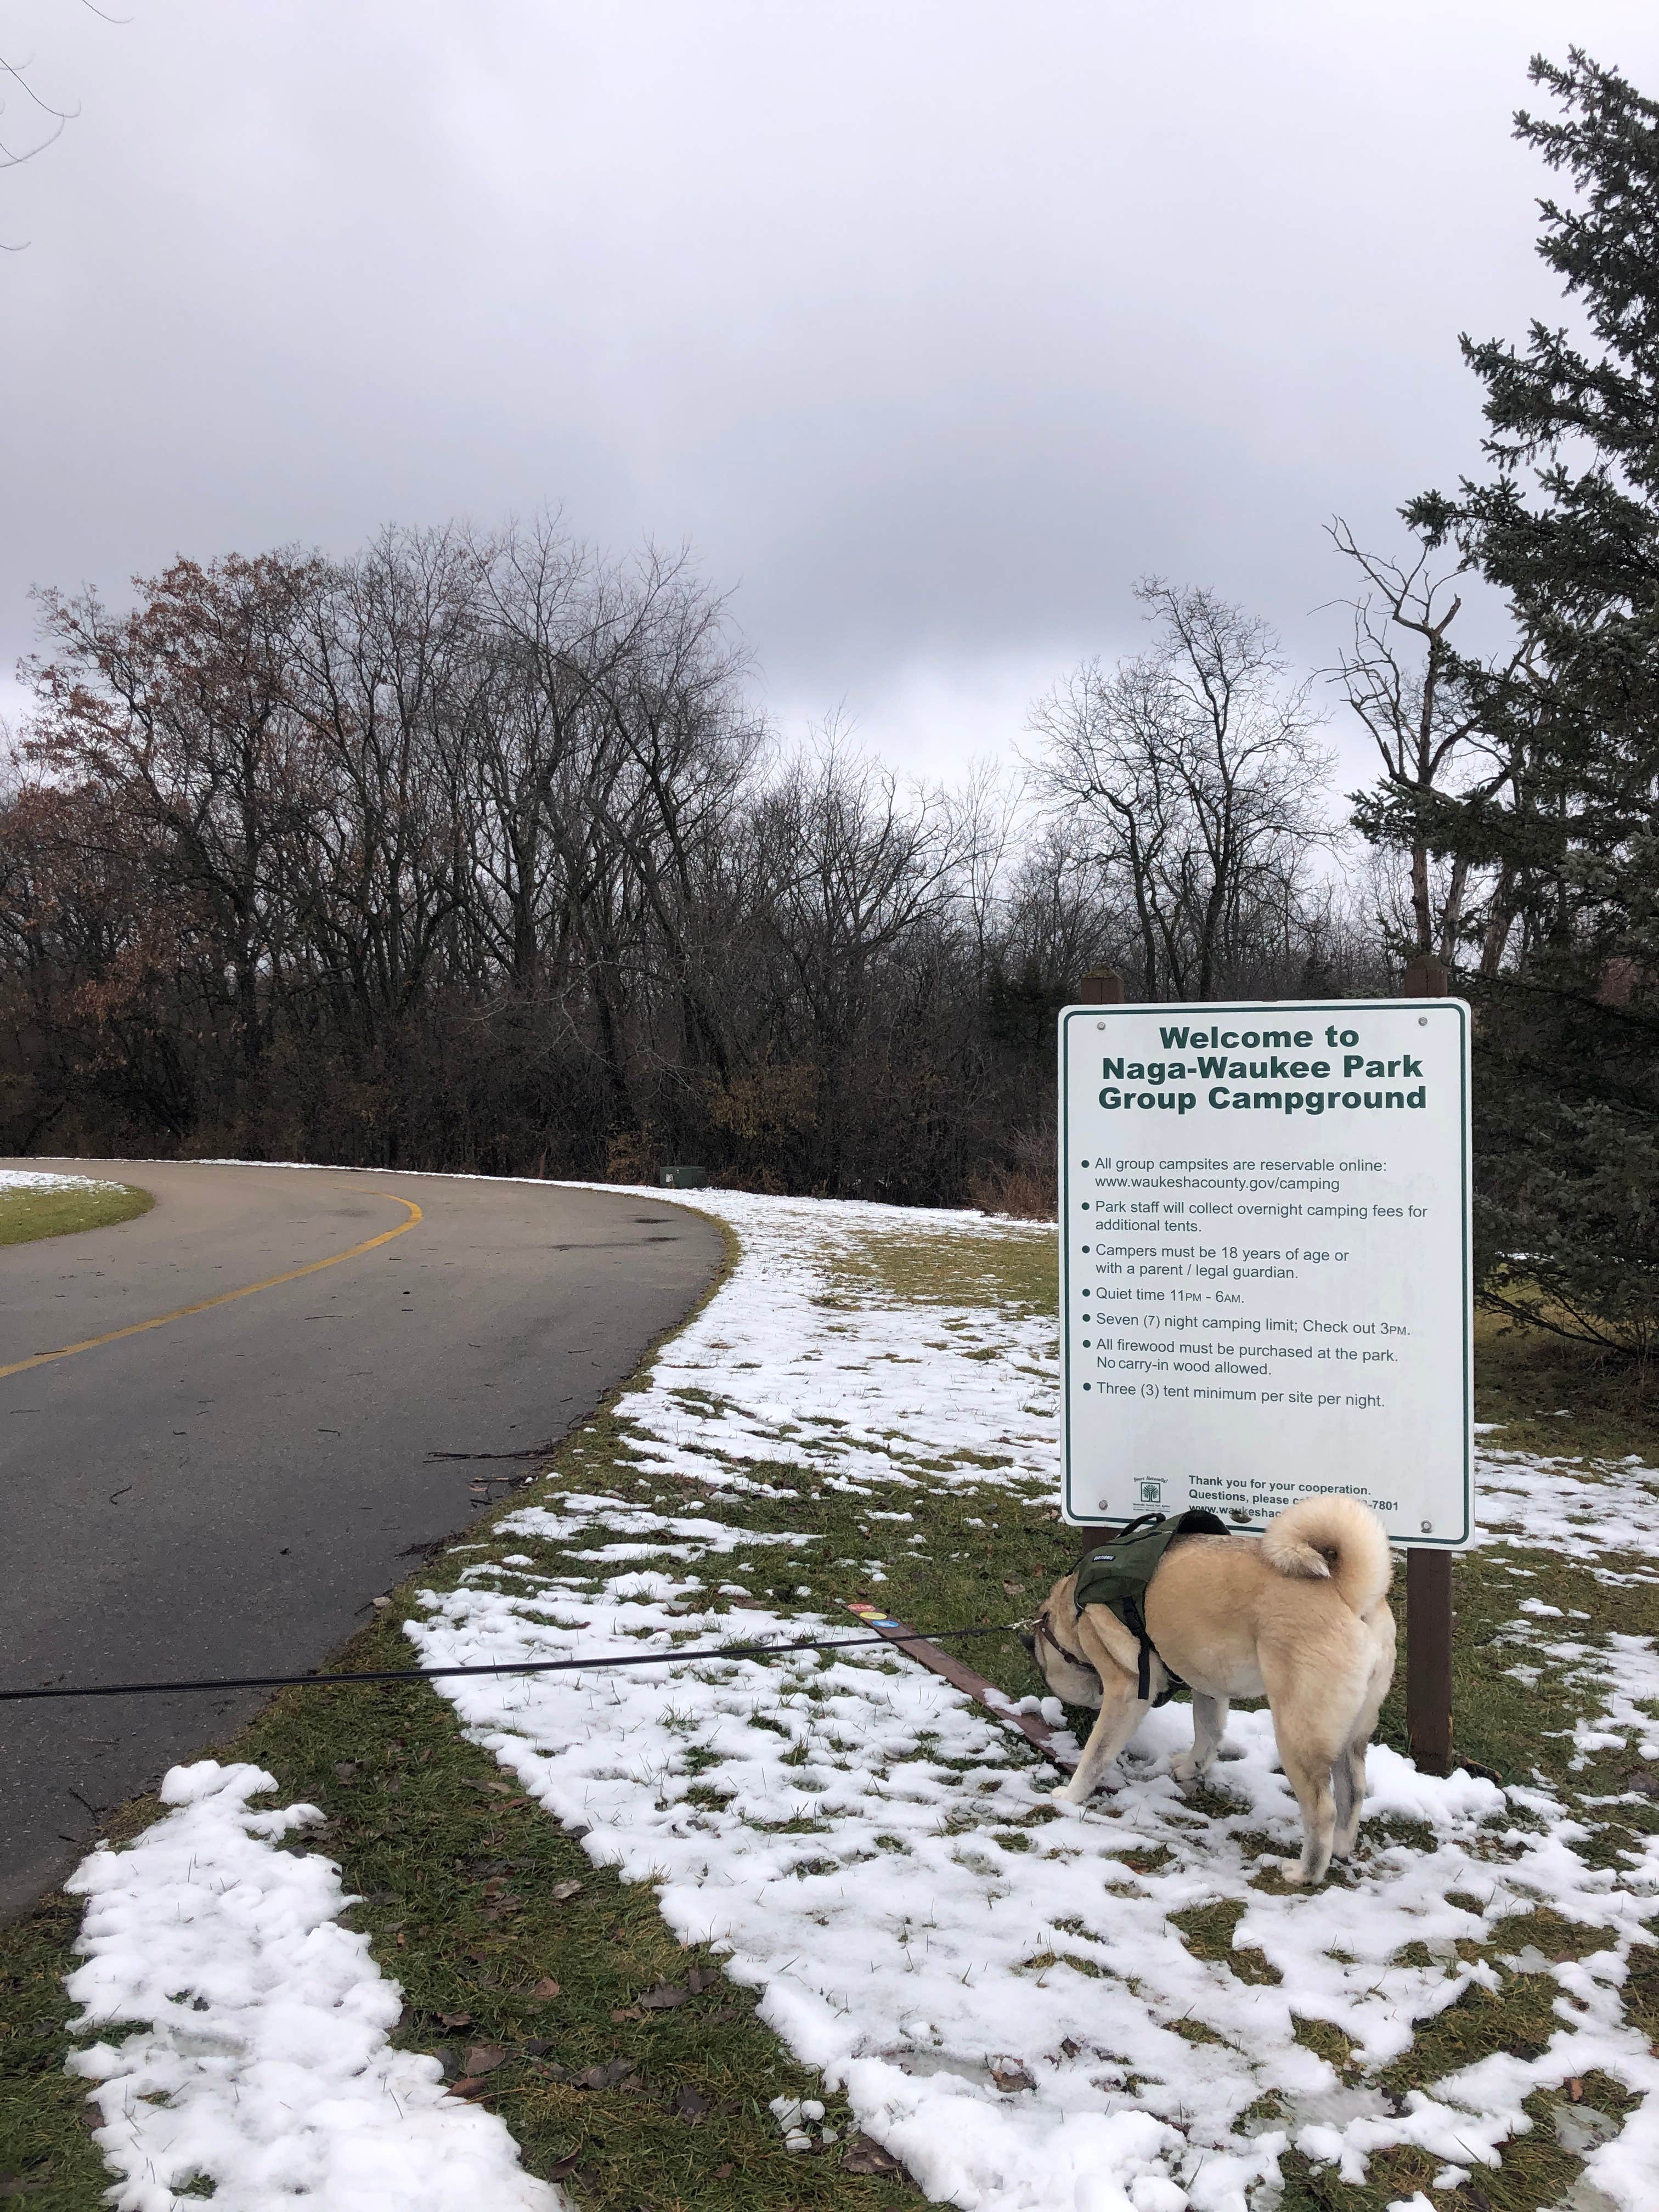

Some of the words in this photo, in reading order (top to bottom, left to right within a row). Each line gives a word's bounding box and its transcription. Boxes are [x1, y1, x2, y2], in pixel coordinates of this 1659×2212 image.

[1159, 1026, 1313, 1049] Welcome
[1325, 1025, 1359, 1047] to
[1103, 1056, 1330, 1085] Naga-Waukee
[1344, 1054, 1424, 1077] Park
[1099, 1087, 1196, 1115] Group
[1209, 1086, 1426, 1115] Campground
[1095, 1158, 1111, 1169] All
[1116, 1160, 1154, 1172] group
[1159, 1158, 1228, 1172] campsites
[1233, 1161, 1255, 1170] are
[1261, 1159, 1334, 1171] reservable
[1339, 1159, 1386, 1171] online:
[1095, 1176, 1339, 1193] www.waukeshacounty.gov/camping
[1096, 1200, 1126, 1212] Park
[1131, 1201, 1160, 1213] staff
[1163, 1201, 1184, 1213] will
[1189, 1203, 1233, 1214] collect
[1238, 1203, 1303, 1218] overnight
[1307, 1204, 1367, 1220] camping
[1372, 1204, 1403, 1217] fees
[1408, 1205, 1427, 1217] for
[1096, 1218, 1160, 1231] additional
[1164, 1220, 1201, 1232] tents.
[1096, 1244, 1157, 1259] Campers
[1160, 1246, 1195, 1257] must
[1199, 1246, 1216, 1258] be
[1222, 1246, 1238, 1259] 18
[1243, 1250, 1280, 1262] years
[1285, 1248, 1299, 1260] of
[1304, 1251, 1330, 1263] age
[1335, 1252, 1349, 1261] or
[1096, 1262, 1122, 1273] with
[1127, 1265, 1135, 1274] a
[1139, 1265, 1183, 1277] parent
[1187, 1264, 1192, 1276] /
[1196, 1264, 1228, 1279] legal
[1233, 1266, 1298, 1280] guardian.
[1096, 1287, 1132, 1299] Quiet
[1136, 1288, 1165, 1300] time
[1171, 1289, 1201, 1302] 11PM
[1216, 1291, 1244, 1303] 6AM.
[1097, 1313, 1138, 1325] Seven
[1144, 1315, 1160, 1329] (7)
[1165, 1315, 1198, 1330] night
[1203, 1317, 1260, 1333] camping
[1266, 1318, 1297, 1333] limit;
[1303, 1319, 1348, 1333] Check
[1353, 1323, 1375, 1334] out
[1380, 1323, 1410, 1335] 3PM.
[1097, 1338, 1113, 1350] All
[1117, 1339, 1174, 1352] firewood
[1180, 1343, 1213, 1354] must
[1218, 1342, 1234, 1355] be
[1239, 1345, 1312, 1358] purchased
[1318, 1347, 1331, 1359] at
[1335, 1347, 1357, 1360] the
[1363, 1349, 1397, 1363] park.
[1097, 1356, 1115, 1368] No
[1119, 1358, 1169, 1373] carry-in
[1173, 1361, 1210, 1372] wood
[1215, 1361, 1271, 1375] allowed.
[1097, 1382, 1136, 1395] Three
[1141, 1384, 1159, 1399] (3)
[1163, 1385, 1189, 1397] tent
[1194, 1387, 1256, 1401] minimum
[1261, 1392, 1284, 1404] per
[1289, 1391, 1313, 1403] site
[1318, 1395, 1341, 1407] per
[1346, 1393, 1384, 1409] night.
[1189, 1475, 1223, 1486] Thank
[1226, 1480, 1246, 1489] you
[1250, 1479, 1266, 1488] for
[1269, 1483, 1295, 1492] your
[1299, 1485, 1370, 1495] cooperation.
[1189, 1489, 1249, 1503] Questions,
[1253, 1493, 1289, 1505] please
